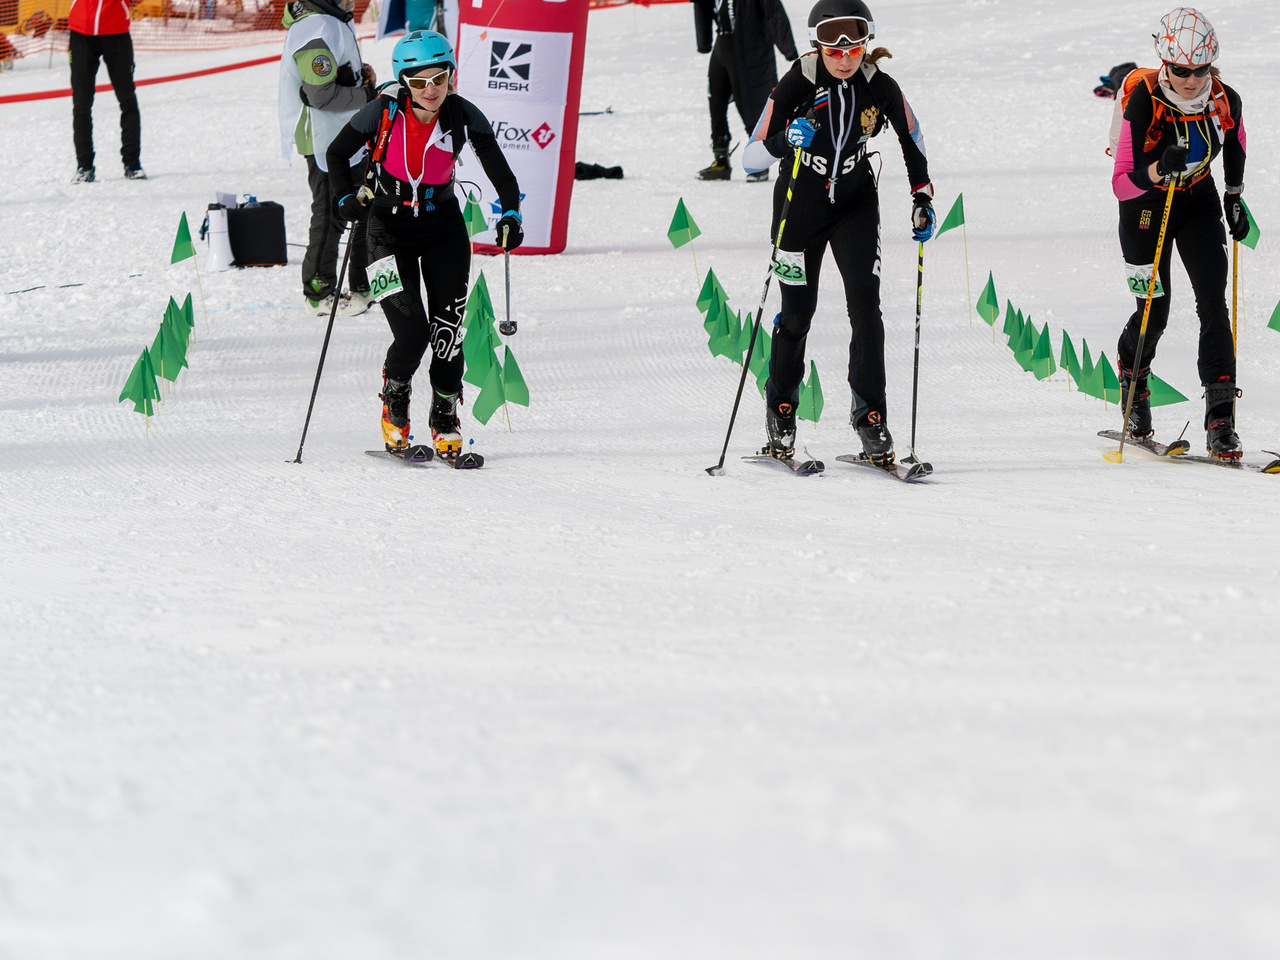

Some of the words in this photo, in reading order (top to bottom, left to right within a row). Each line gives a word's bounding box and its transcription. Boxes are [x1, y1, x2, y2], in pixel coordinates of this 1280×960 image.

[487, 80, 530, 92] BASK
[500, 143, 530, 151] ipment
[774, 259, 803, 279] 223
[370, 270, 399, 296] 204
